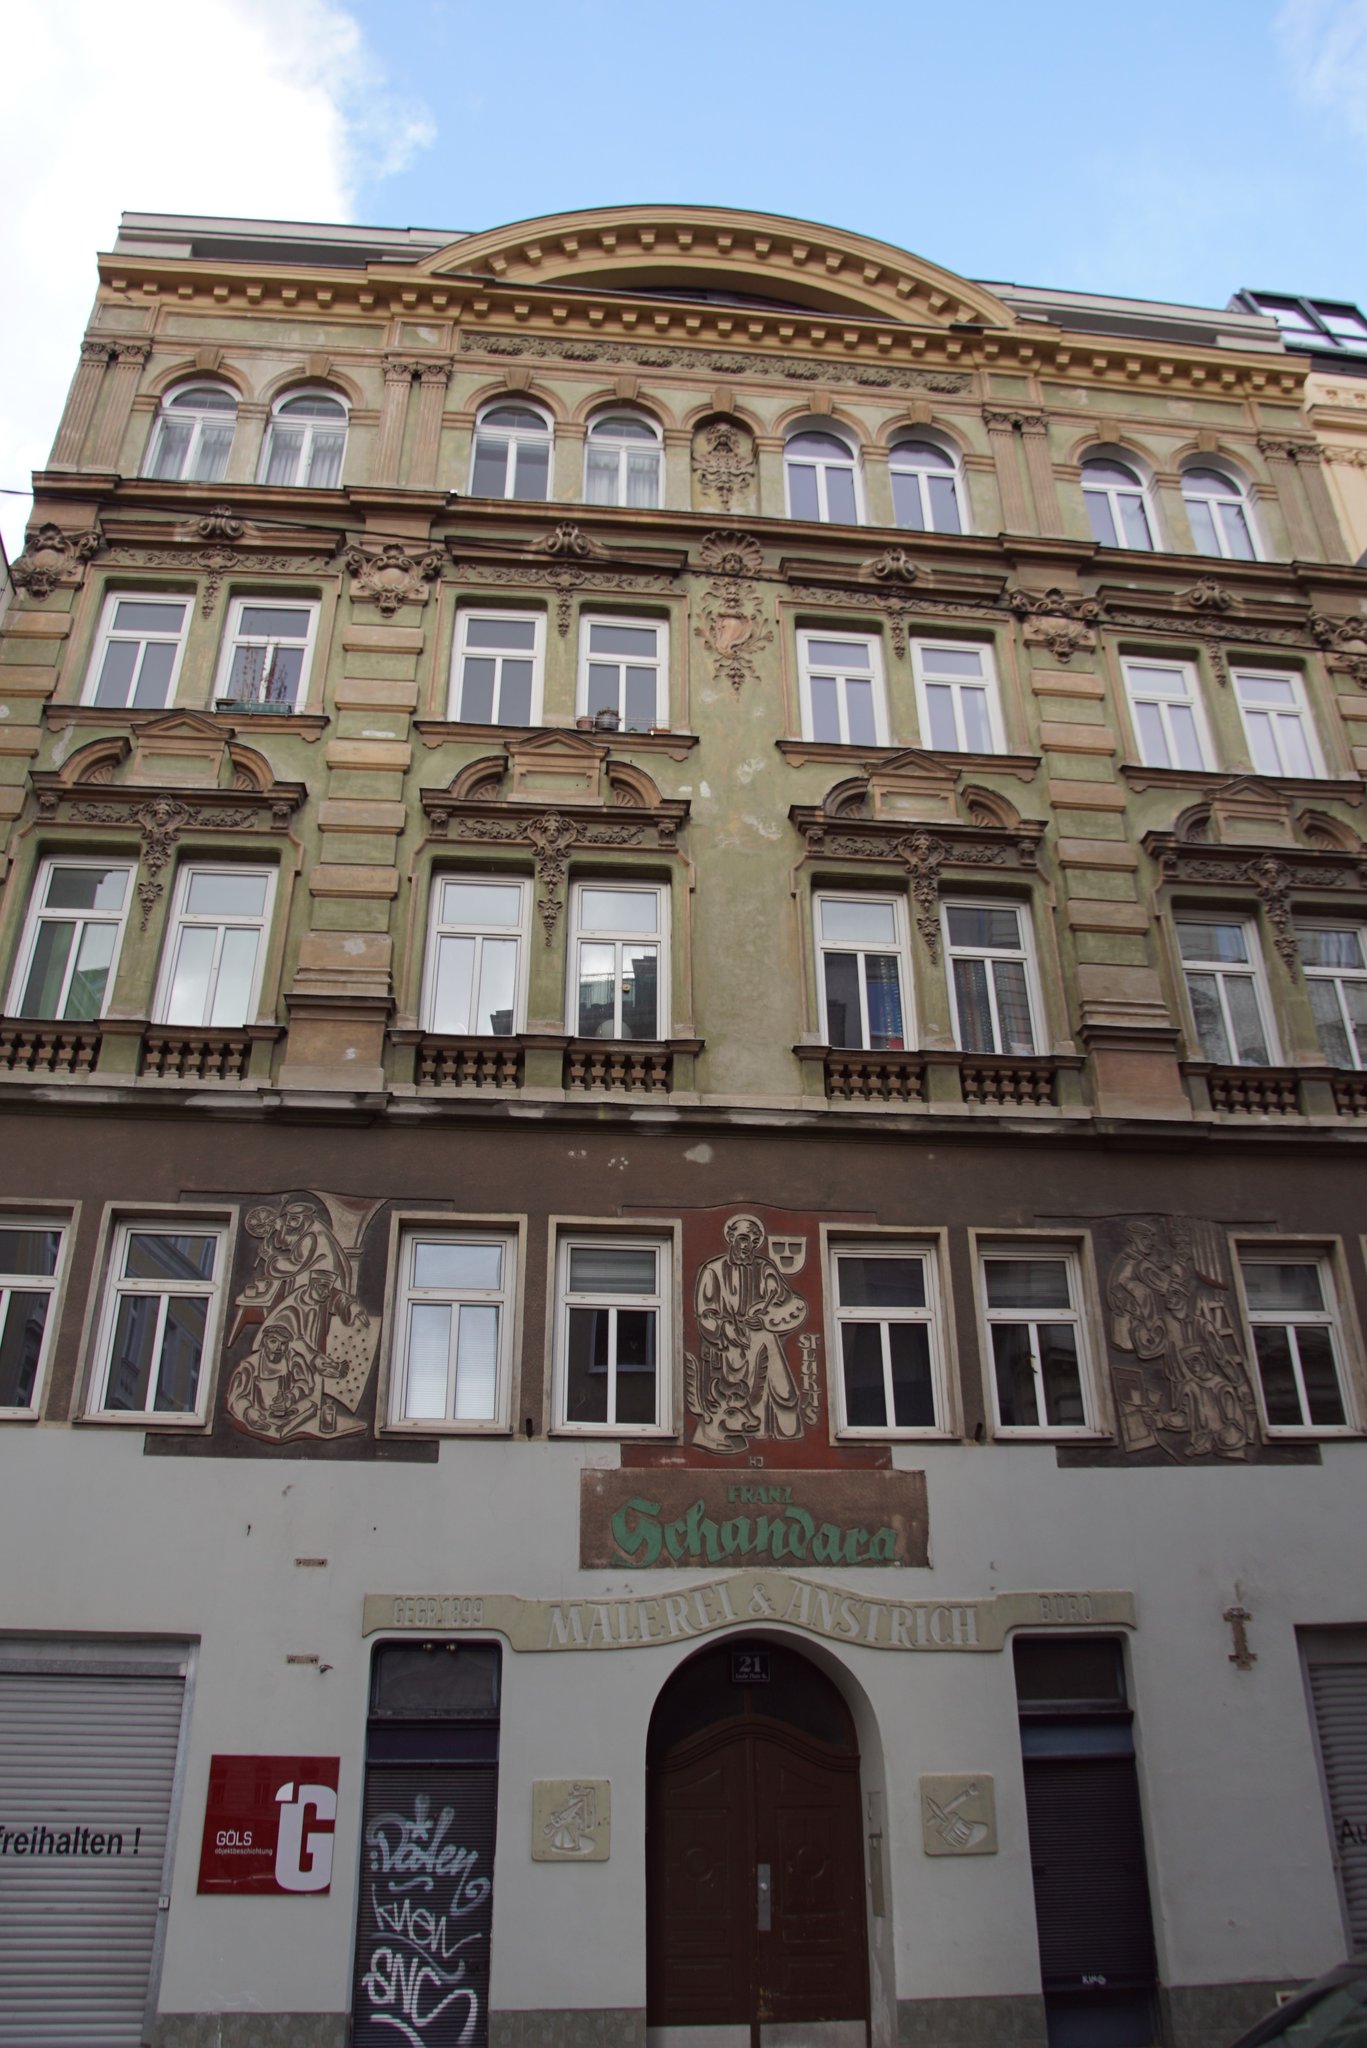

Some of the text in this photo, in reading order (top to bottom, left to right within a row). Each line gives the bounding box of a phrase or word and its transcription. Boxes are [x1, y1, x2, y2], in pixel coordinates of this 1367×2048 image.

[727, 1485, 794, 1504] FRANZ
[611, 1496, 898, 1568] Schandara
[548, 1580, 980, 1647] MALEREI & ANSTRICH
[740, 1655, 761, 1672] 21
[216, 1829, 252, 1846] GÖLS
[215, 1847, 273, 1856] objektbeschichtung
